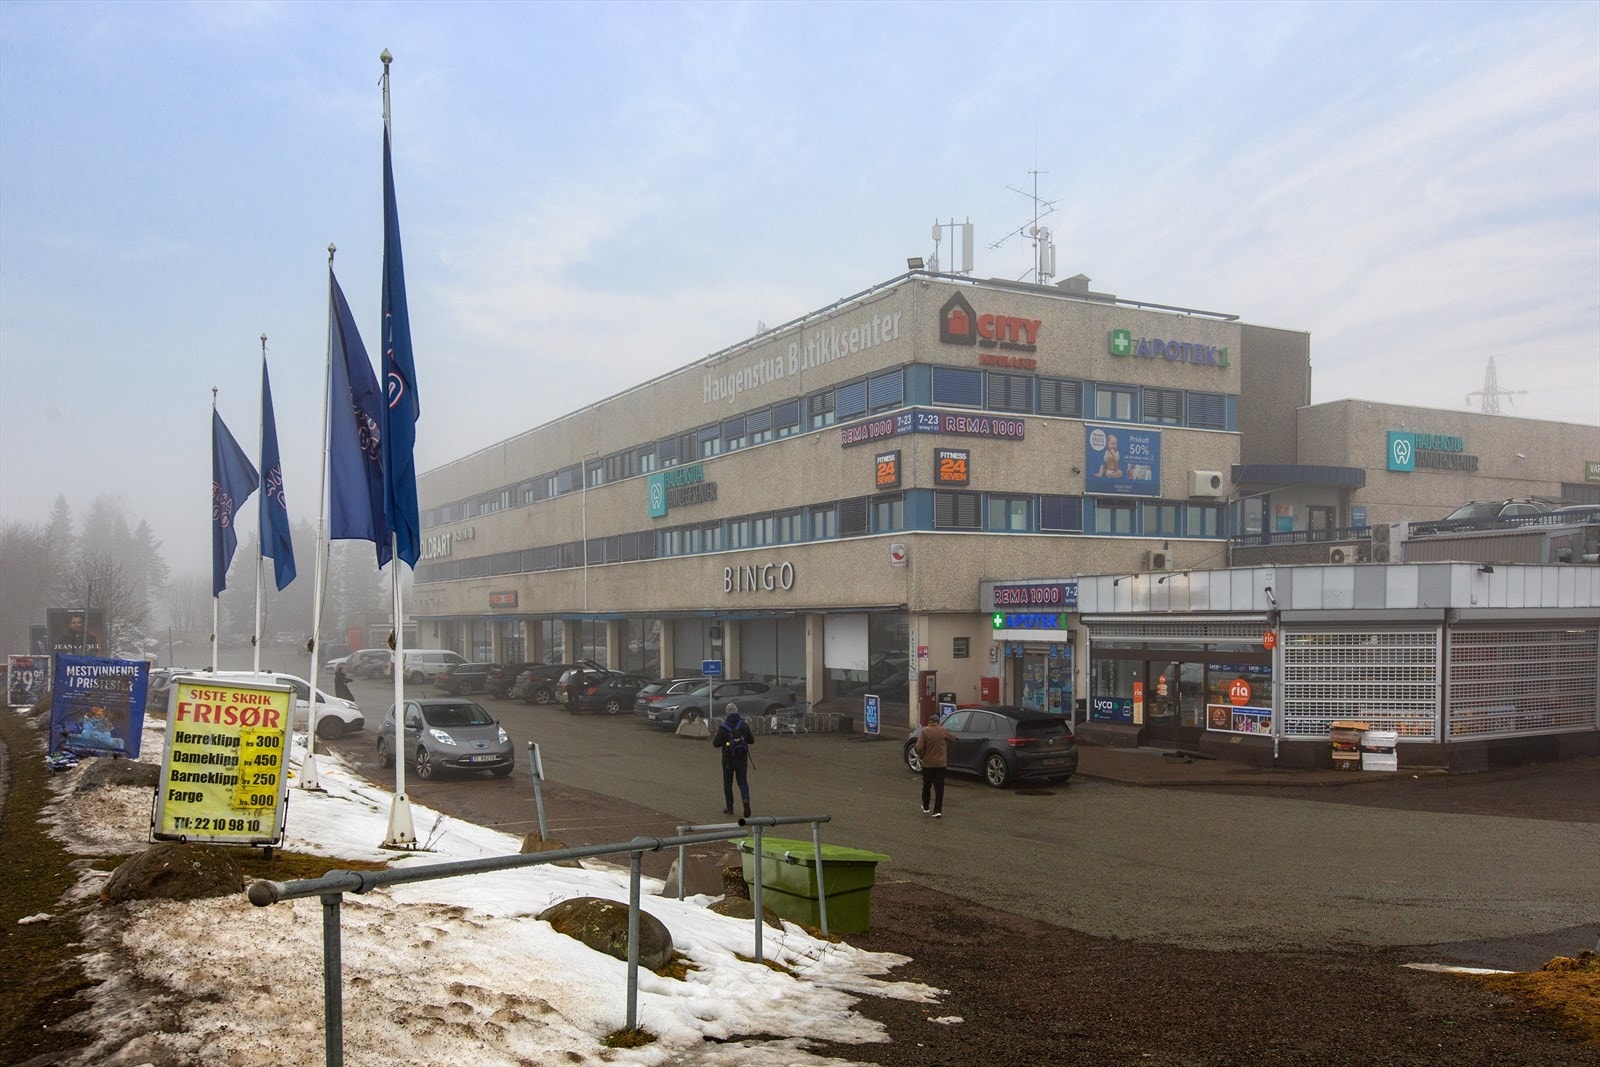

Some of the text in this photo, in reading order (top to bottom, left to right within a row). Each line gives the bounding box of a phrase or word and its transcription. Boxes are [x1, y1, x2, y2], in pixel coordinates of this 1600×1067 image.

[977, 313, 1042, 345] CITY
[703, 310, 902, 405] Haugenstua Butikksenter
[1137, 337, 1231, 368] APOTEK 1
[897, 414, 911, 427] 7-23
[918, 414, 939, 425] 7-23
[945, 417, 1024, 437] REMA 1000
[841, 419, 892, 445] REMA 1000
[940, 452, 967, 460] FITNESS
[1129, 444, 1150, 455] 50%
[877, 455, 896, 464] FITNESS
[940, 459, 967, 473] 24
[877, 463, 896, 476] 24
[940, 472, 967, 481] SEVEN
[877, 474, 896, 484] SEVEN
[723, 561, 795, 593] BINGO
[994, 587, 1059, 604] REMA 1000
[1065, 586, 1077, 597] 7-2
[1006, 612, 1067, 629] APOTEK 1
[1264, 633, 1274, 643] ria
[66, 666, 140, 677] MESTVINNENDE
[190, 689, 272, 706] SISTE SKRIK
[1231, 682, 1248, 697] ria
[1094, 698, 1113, 710] Lyca
[176, 702, 280, 729] FRISØR
[175, 731, 279, 748] Herreklipp fra 300
[173, 750, 239, 767] Dameklipp
[253, 754, 277, 767] 450
[170, 769, 239, 786] Barneklipp
[252, 773, 276, 786] 250
[168, 788, 204, 803] Farge
[250, 794, 274, 806] 900
[174, 816, 260, 832] Tlf: 22 10 98 10
